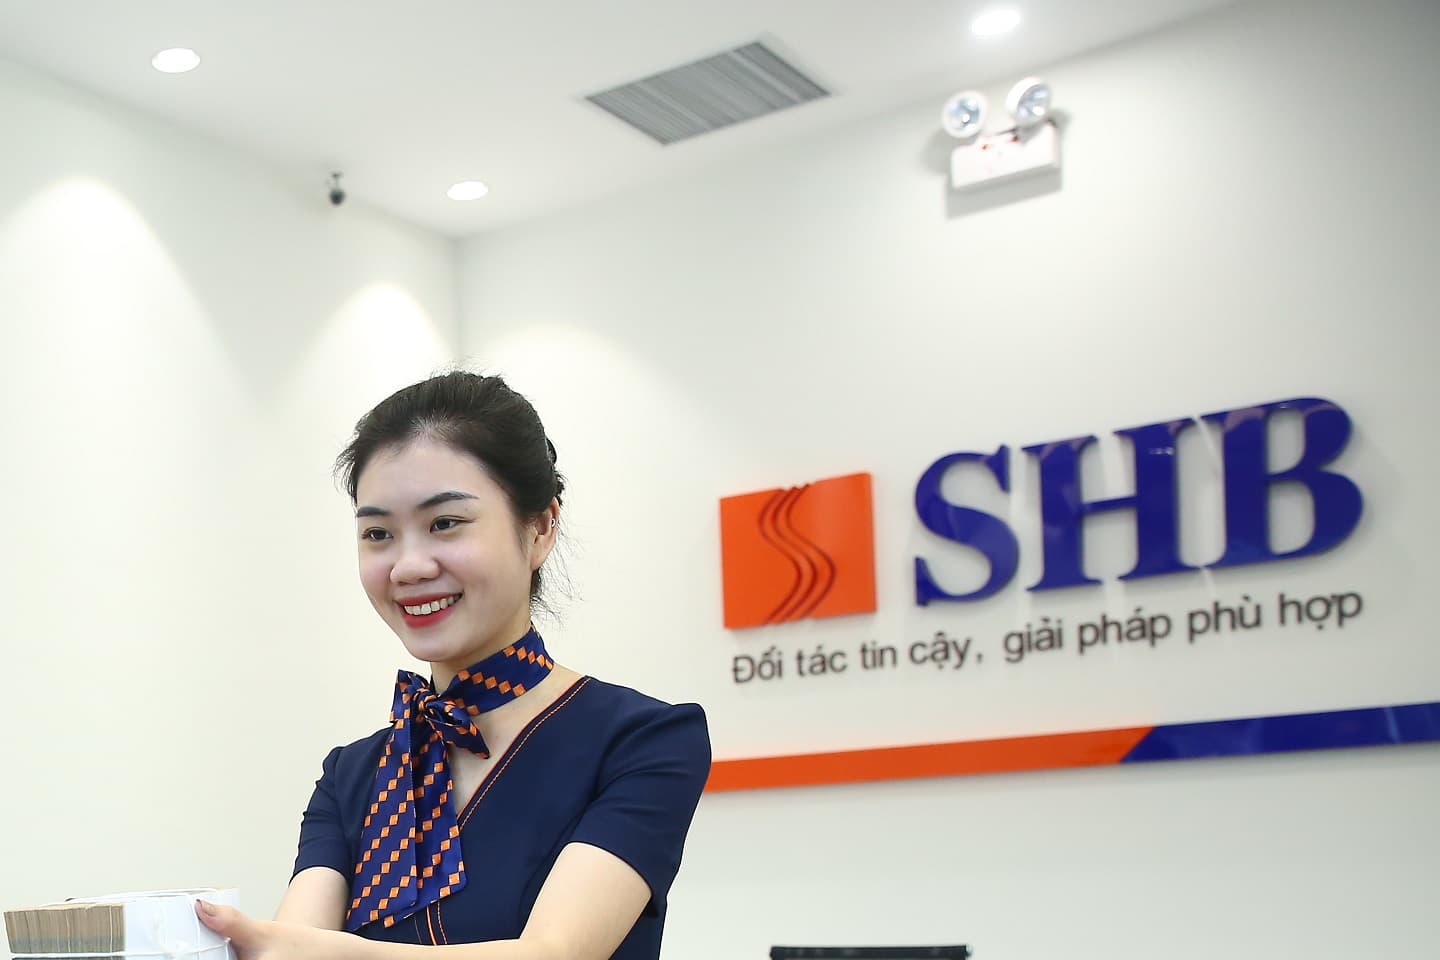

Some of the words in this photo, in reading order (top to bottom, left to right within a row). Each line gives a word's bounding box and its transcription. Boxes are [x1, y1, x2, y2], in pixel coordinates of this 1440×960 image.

[915, 396, 1365, 607] SHB
[732, 644, 783, 684] Đối
[796, 643, 847, 676] tác
[860, 641, 897, 670] tin
[909, 630, 984, 669] cậy,
[1004, 612, 1063, 663] giải
[1078, 607, 1172, 655] pháp
[1187, 594, 1262, 643] phù
[1278, 591, 1364, 631] hợp
